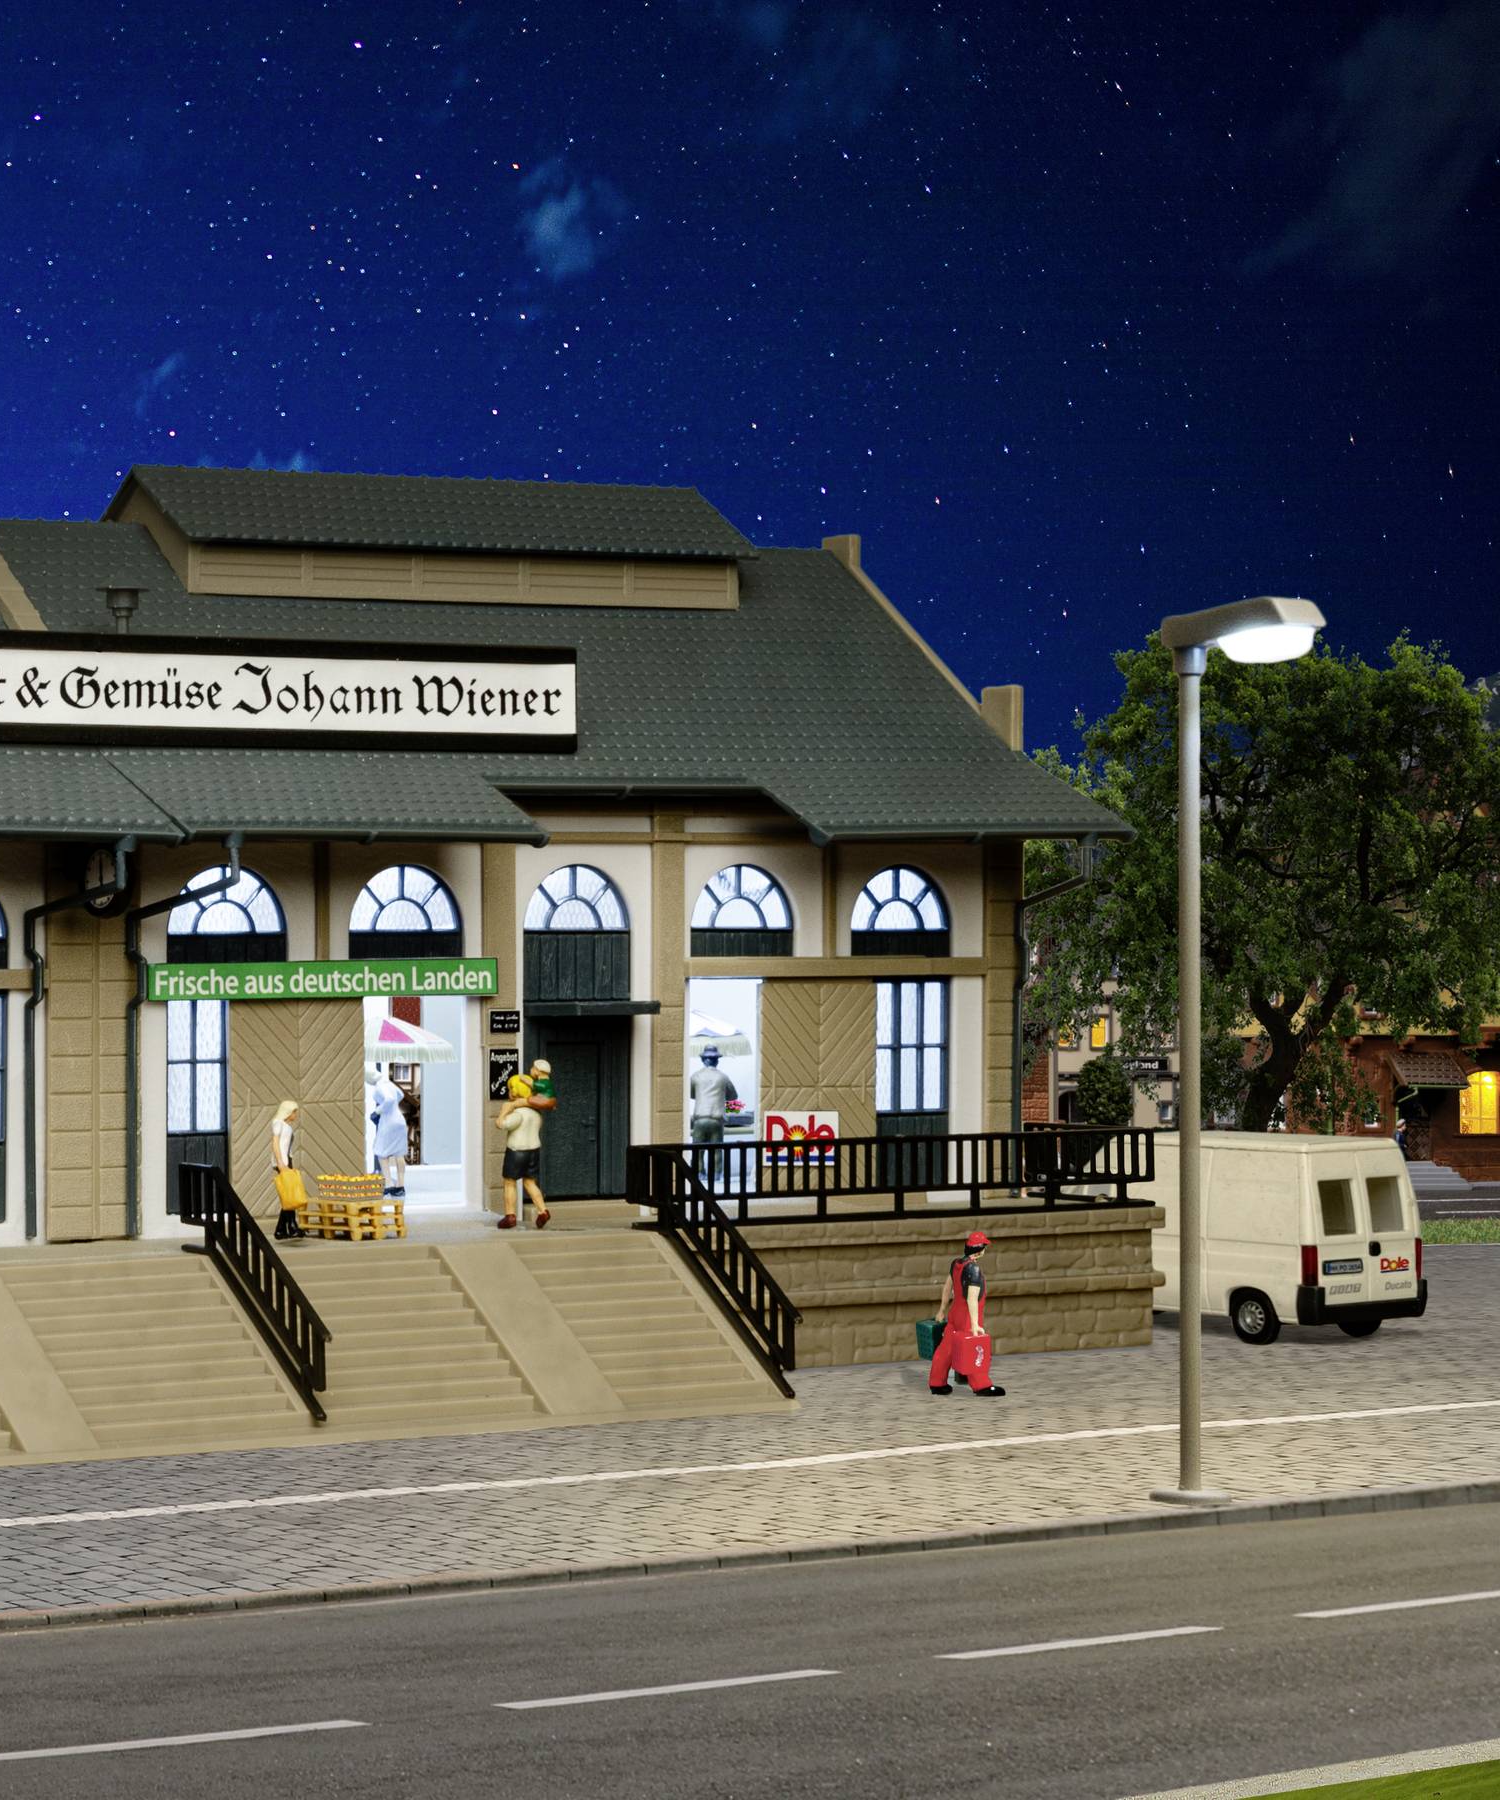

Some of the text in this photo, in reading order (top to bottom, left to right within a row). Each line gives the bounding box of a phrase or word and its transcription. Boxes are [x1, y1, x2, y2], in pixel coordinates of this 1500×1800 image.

[16, 666, 51, 708] &
[60, 666, 223, 710] Gemüse
[233, 662, 404, 721] Johann
[412, 675, 562, 717] Wiener
[155, 965, 492, 996] Frische aus deutschen Landen
[766, 1115, 835, 1152] Dole
[1380, 1257, 1409, 1271] Dole
[1385, 1281, 1412, 1291] Ducato
